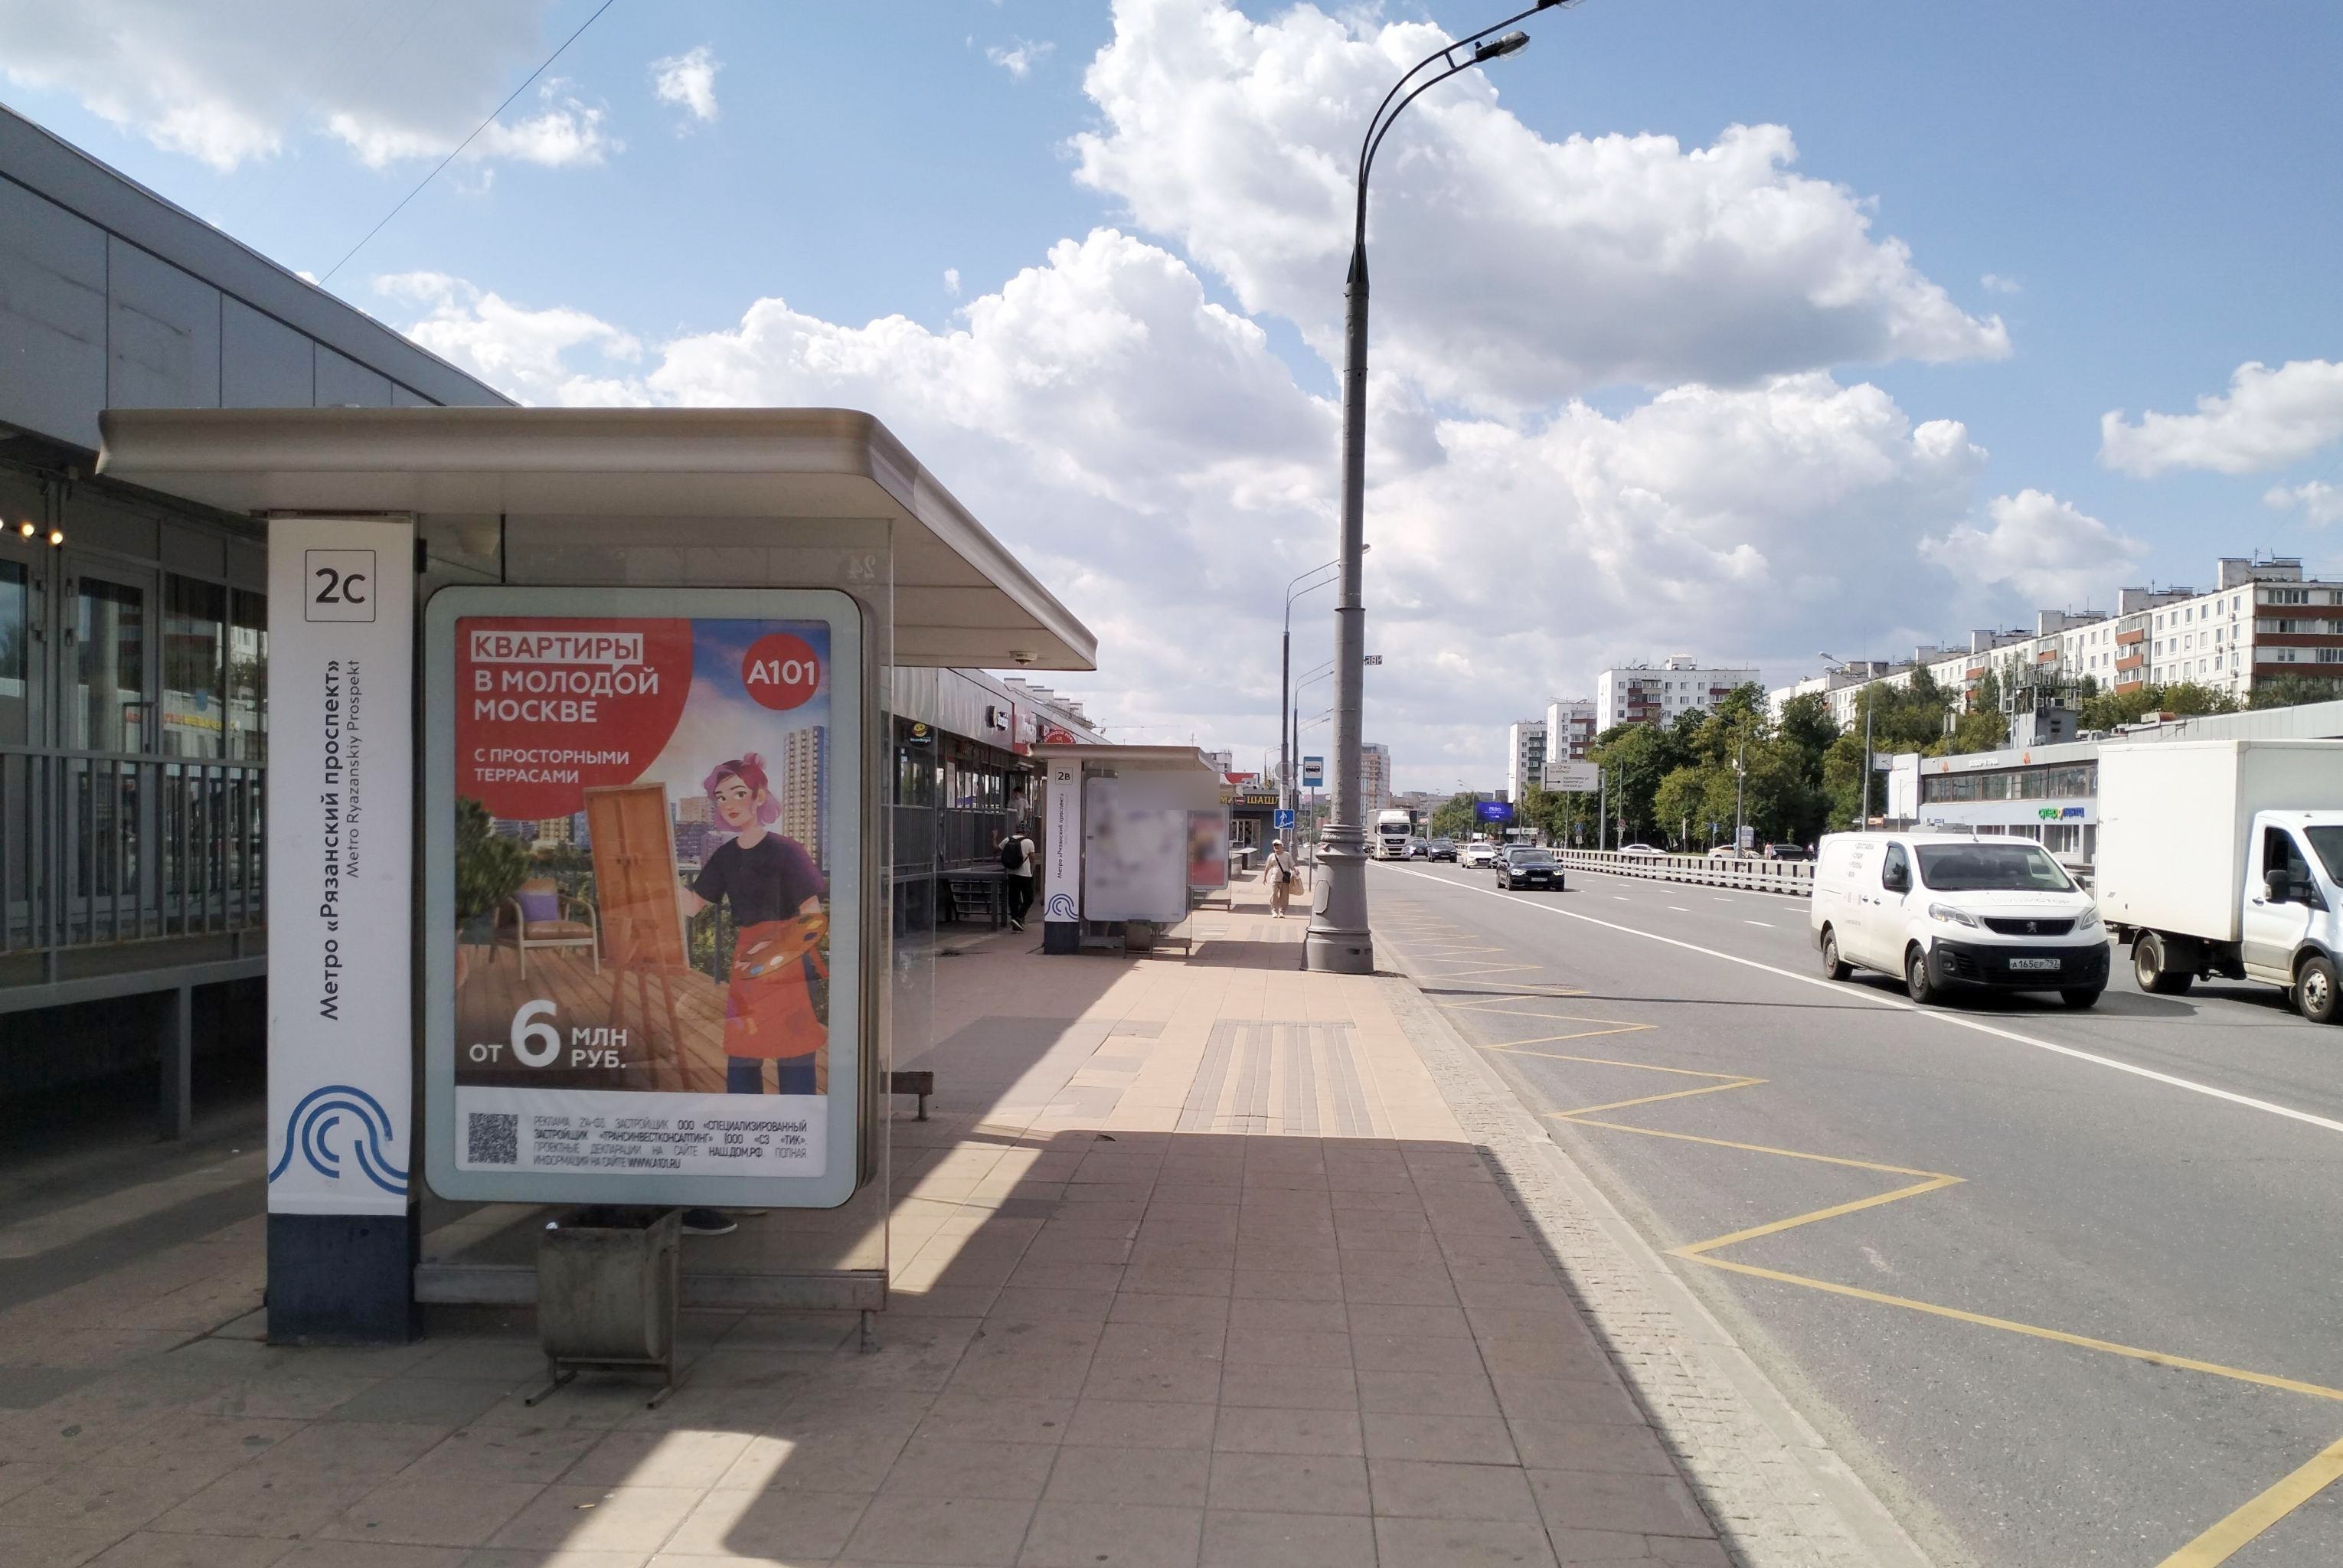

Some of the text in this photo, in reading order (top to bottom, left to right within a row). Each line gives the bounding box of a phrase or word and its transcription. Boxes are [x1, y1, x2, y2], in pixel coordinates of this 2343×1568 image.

[315, 567, 366, 603] 2C
[475, 636, 638, 660] КВАРТИРЫ
[475, 666, 659, 698] В МОЛОДОЙ
[747, 659, 815, 685] A101
[475, 699, 598, 723] МОСКВЕ
[347, 659, 363, 878] Metro Ryazanskiy Prospekt
[475, 749, 630, 765] С ПРОСТОРНЫМИ
[475, 768, 580, 783] ТЕРРАСАМИ
[1057, 772, 1070, 780] 2B
[1247, 796, 1280, 805] ШАШЛ
[320, 660, 343, 1021] Метро «Рязанский проспект»
[469, 999, 628, 1068] ОТ 6 МЛН
[571, 1050, 627, 1069] РУБ.
[678, 1120, 695, 1131] ООО
[652, 1145, 663, 1155] НА
